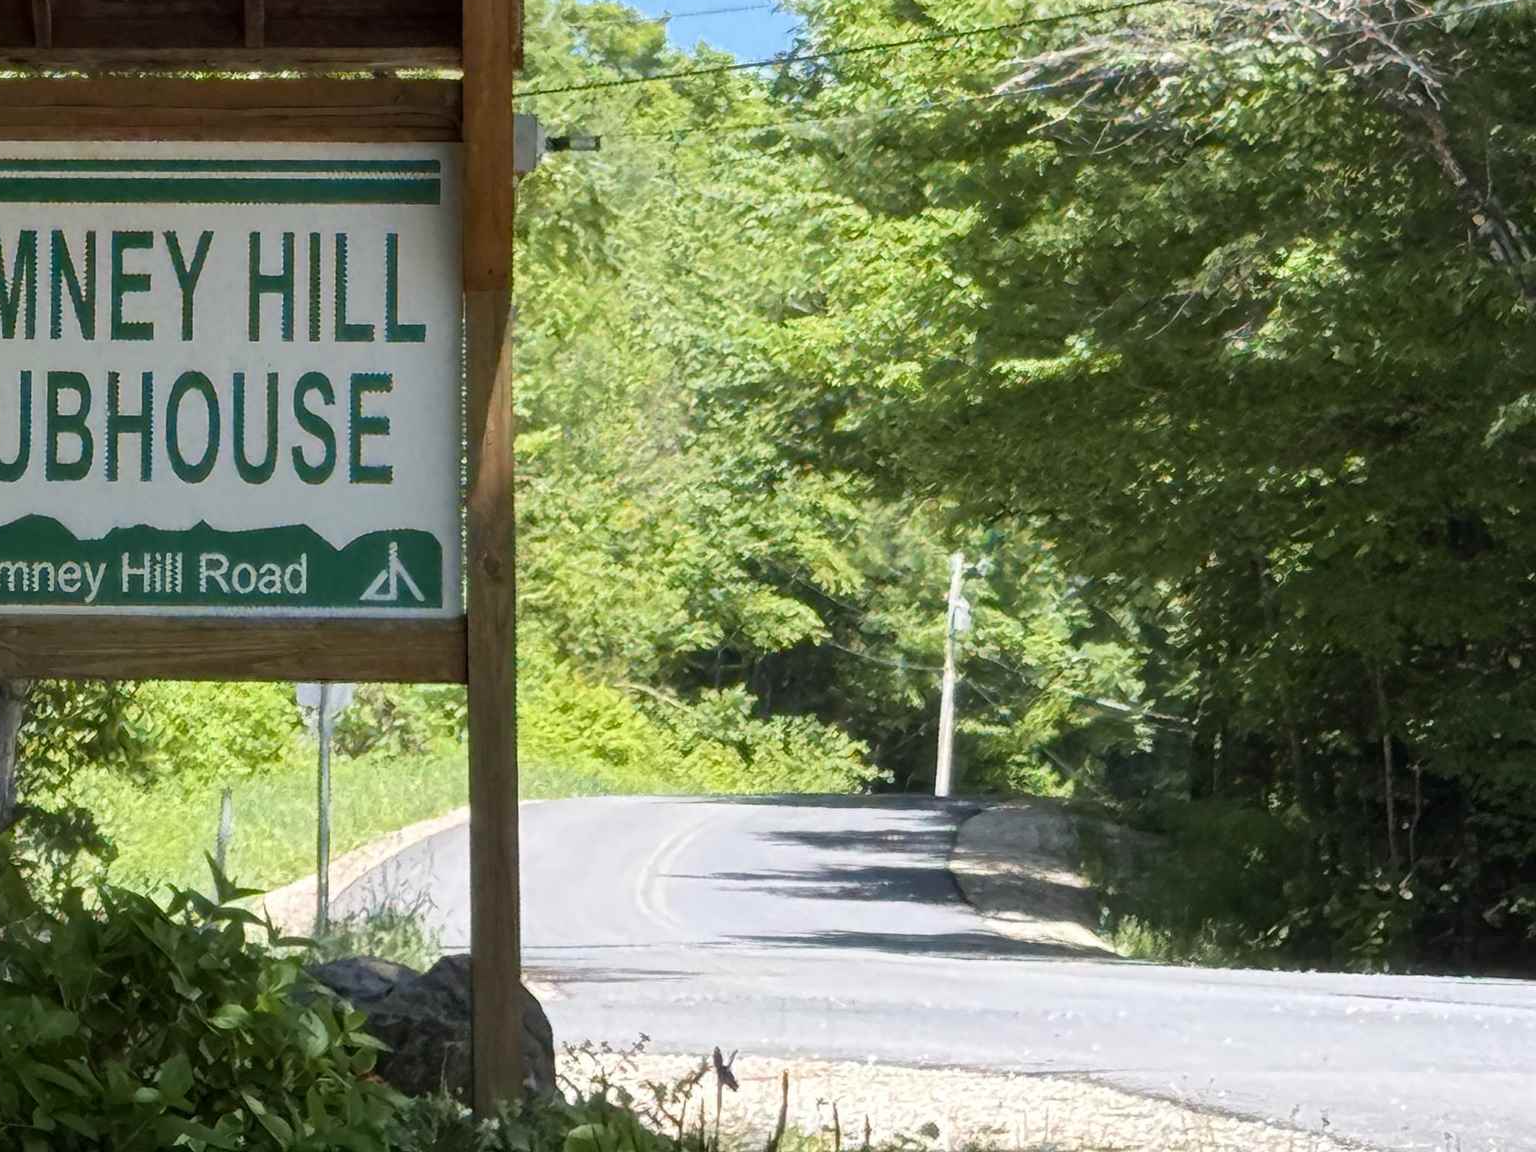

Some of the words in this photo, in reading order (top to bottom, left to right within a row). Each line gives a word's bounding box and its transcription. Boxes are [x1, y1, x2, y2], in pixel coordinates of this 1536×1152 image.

[247, 230, 428, 344] HILL
[120, 553, 183, 595] Hill
[199, 552, 309, 596] Road
